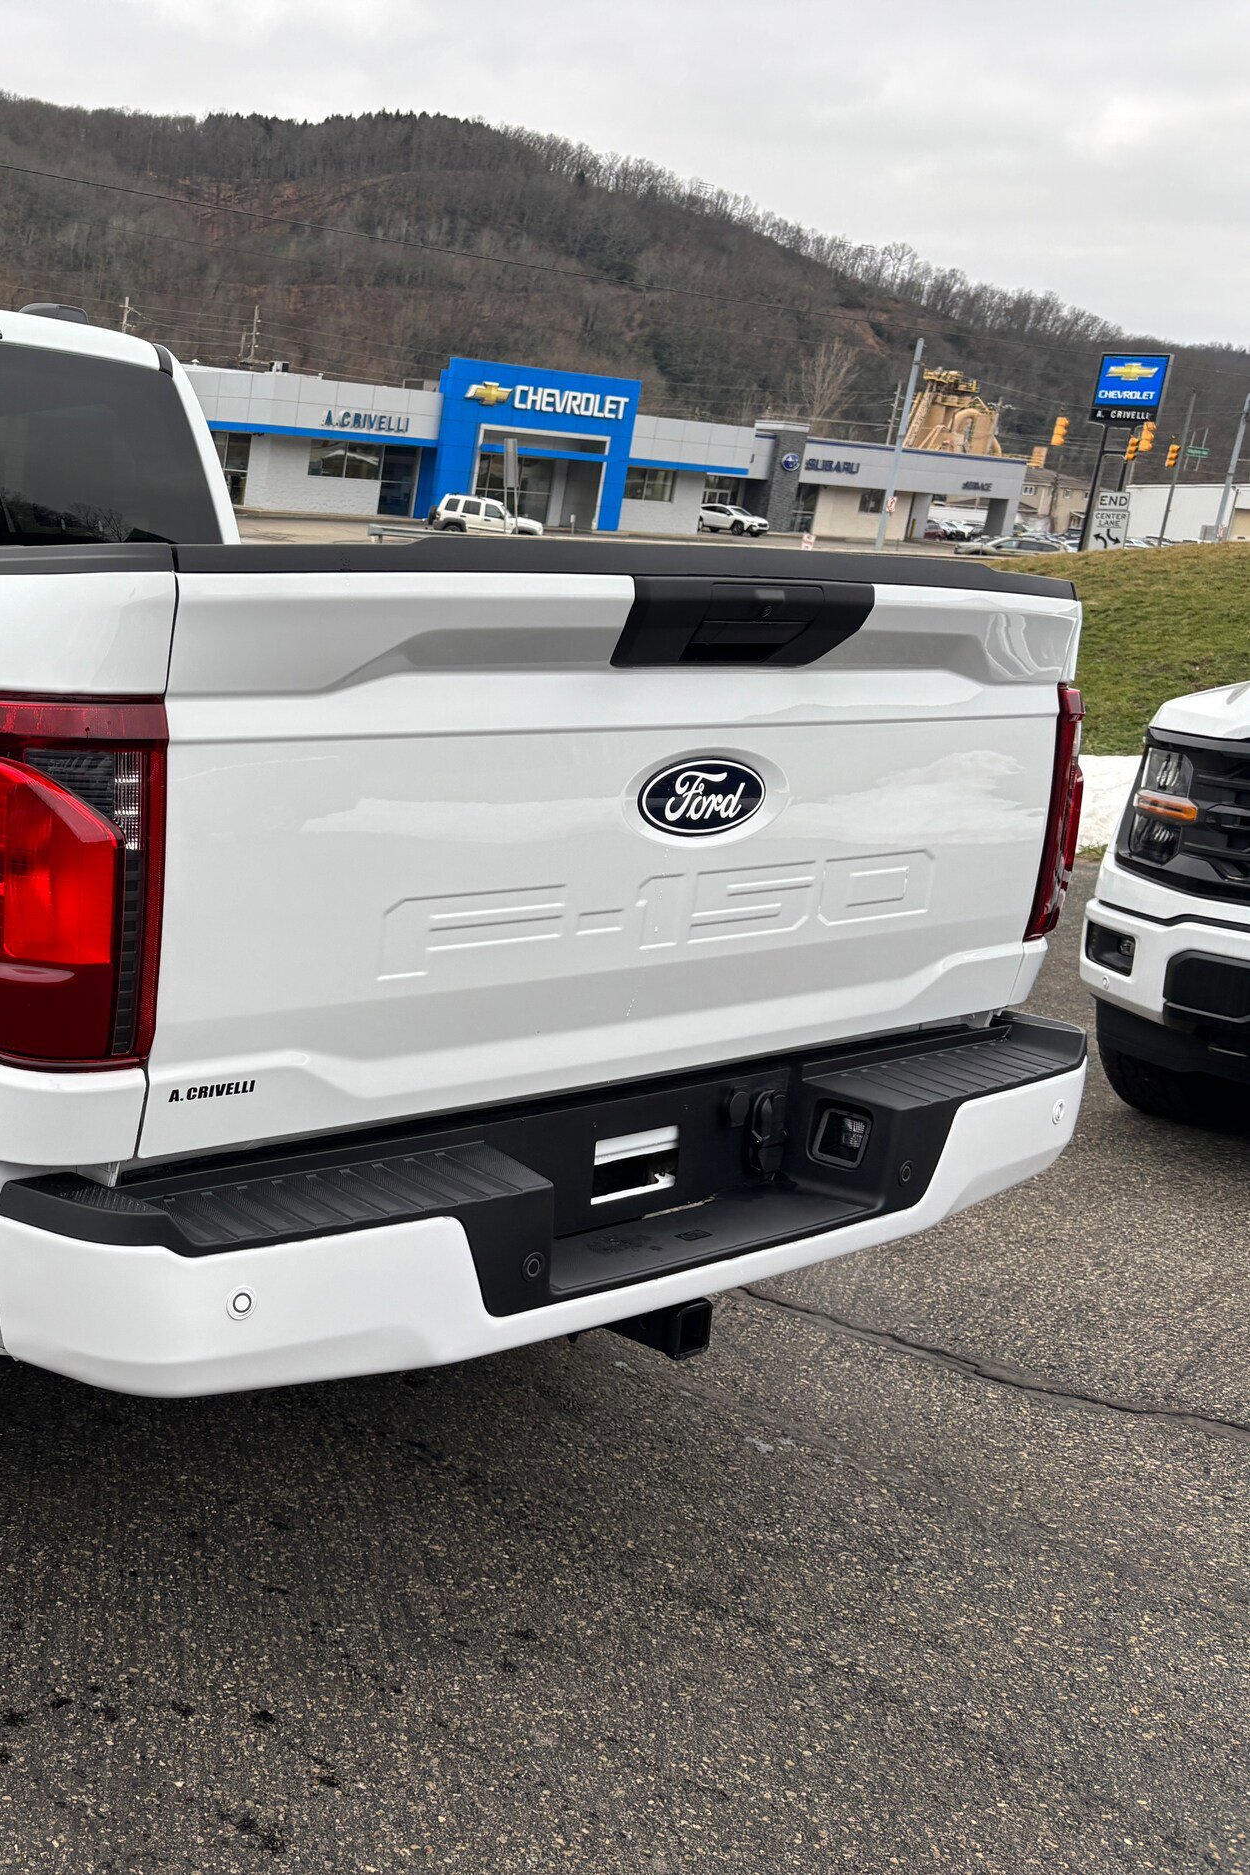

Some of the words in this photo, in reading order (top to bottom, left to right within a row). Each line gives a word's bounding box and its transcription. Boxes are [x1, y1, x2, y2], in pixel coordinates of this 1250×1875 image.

[1098, 389, 1156, 400] CHEVROLET
[514, 385, 629, 420] CHEVROLET
[1096, 410, 1105, 418] A.
[1110, 410, 1150, 420] CRIVELLI
[805, 458, 861, 475] SUBARU
[1099, 495, 1128, 507] END
[1095, 512, 1126, 520] CENTER
[664, 771, 746, 822] Ford
[376, 848, 936, 981] F-150
